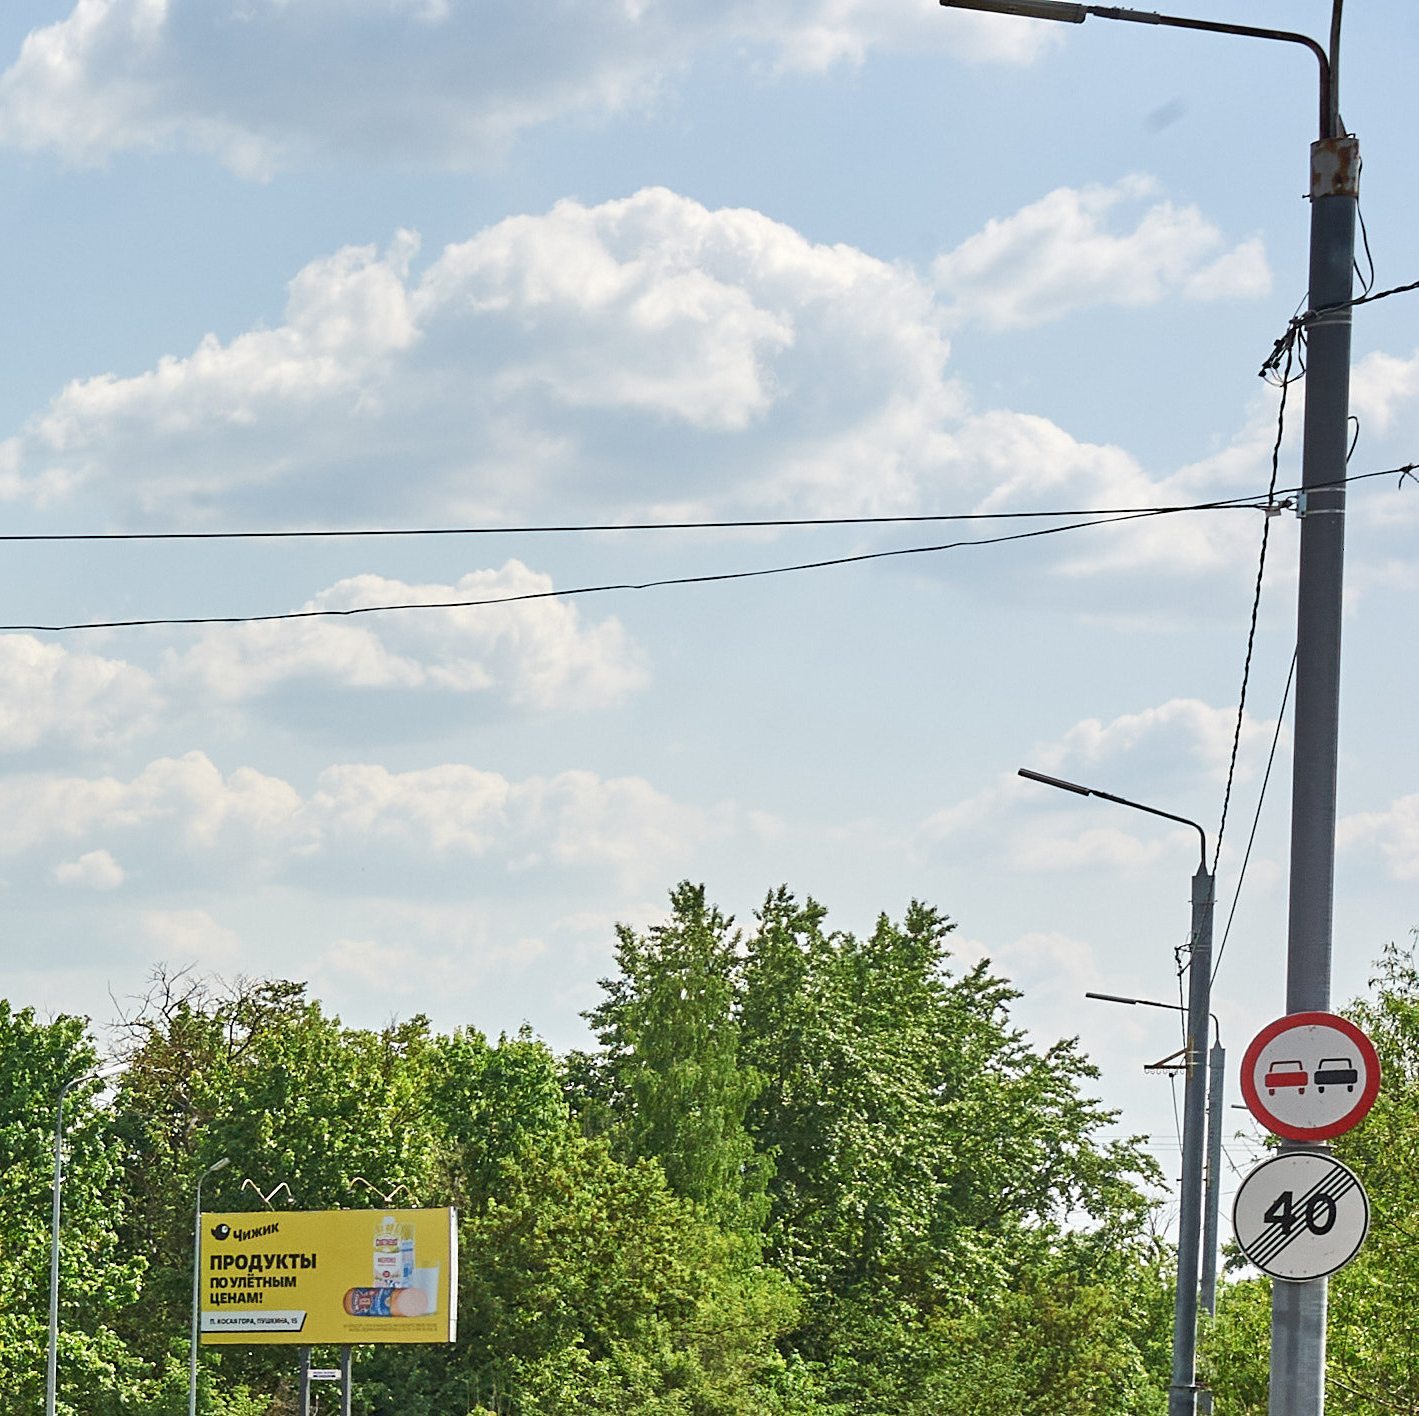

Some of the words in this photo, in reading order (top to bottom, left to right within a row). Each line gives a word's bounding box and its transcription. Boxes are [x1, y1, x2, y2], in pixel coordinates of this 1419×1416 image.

[1264, 1191, 1337, 1236] 40
[210, 1253, 316, 1272] ПРОДУКТЫ
[210, 1278, 229, 1288] ПО
[230, 1274, 297, 1288] УЛЁТНЫМ
[210, 1292, 263, 1306] ЦЕНАМ!
